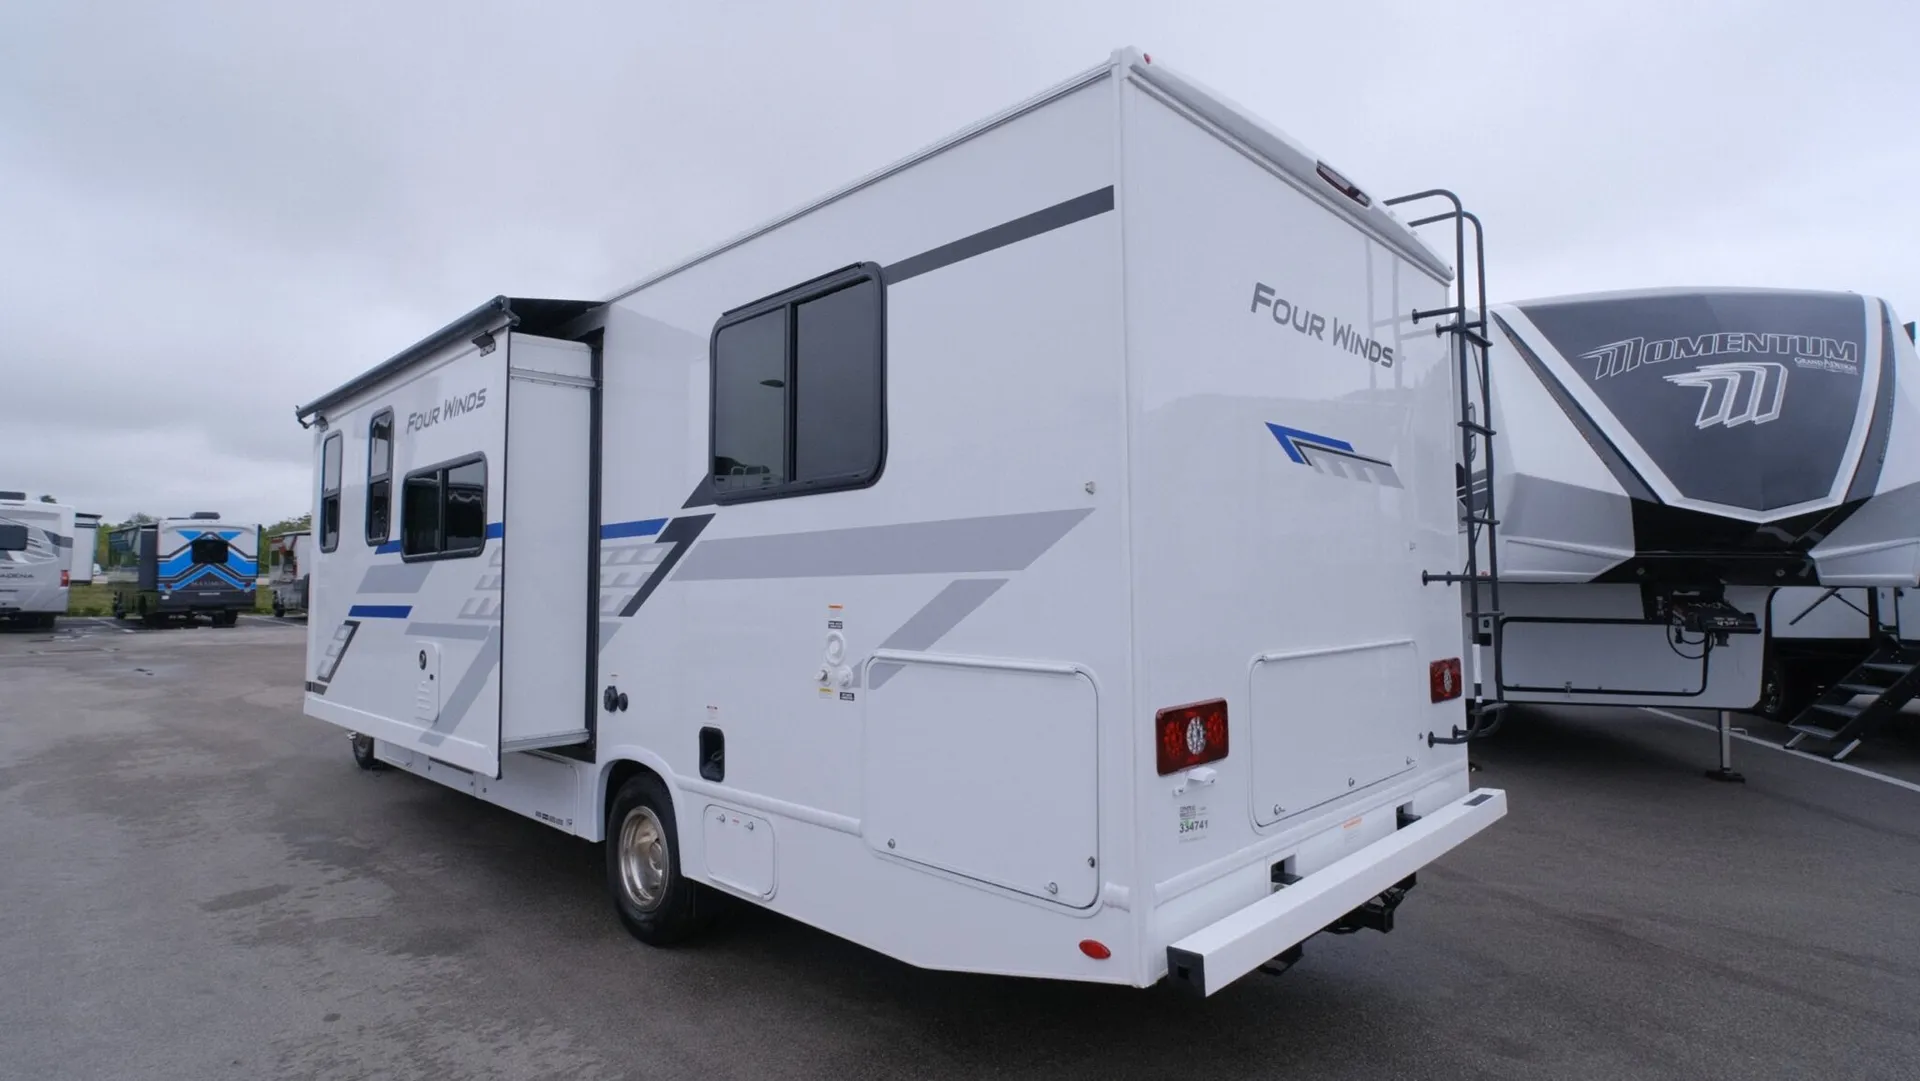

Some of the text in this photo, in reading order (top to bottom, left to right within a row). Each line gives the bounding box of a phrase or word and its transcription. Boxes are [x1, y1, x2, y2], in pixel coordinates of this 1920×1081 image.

[1251, 281, 1394, 369] FOUR WINDS
[1576, 331, 1858, 381] MOMENTUM
[406, 387, 487, 435] FOUR WINDS
[1179, 820, 1208, 833] 334741
